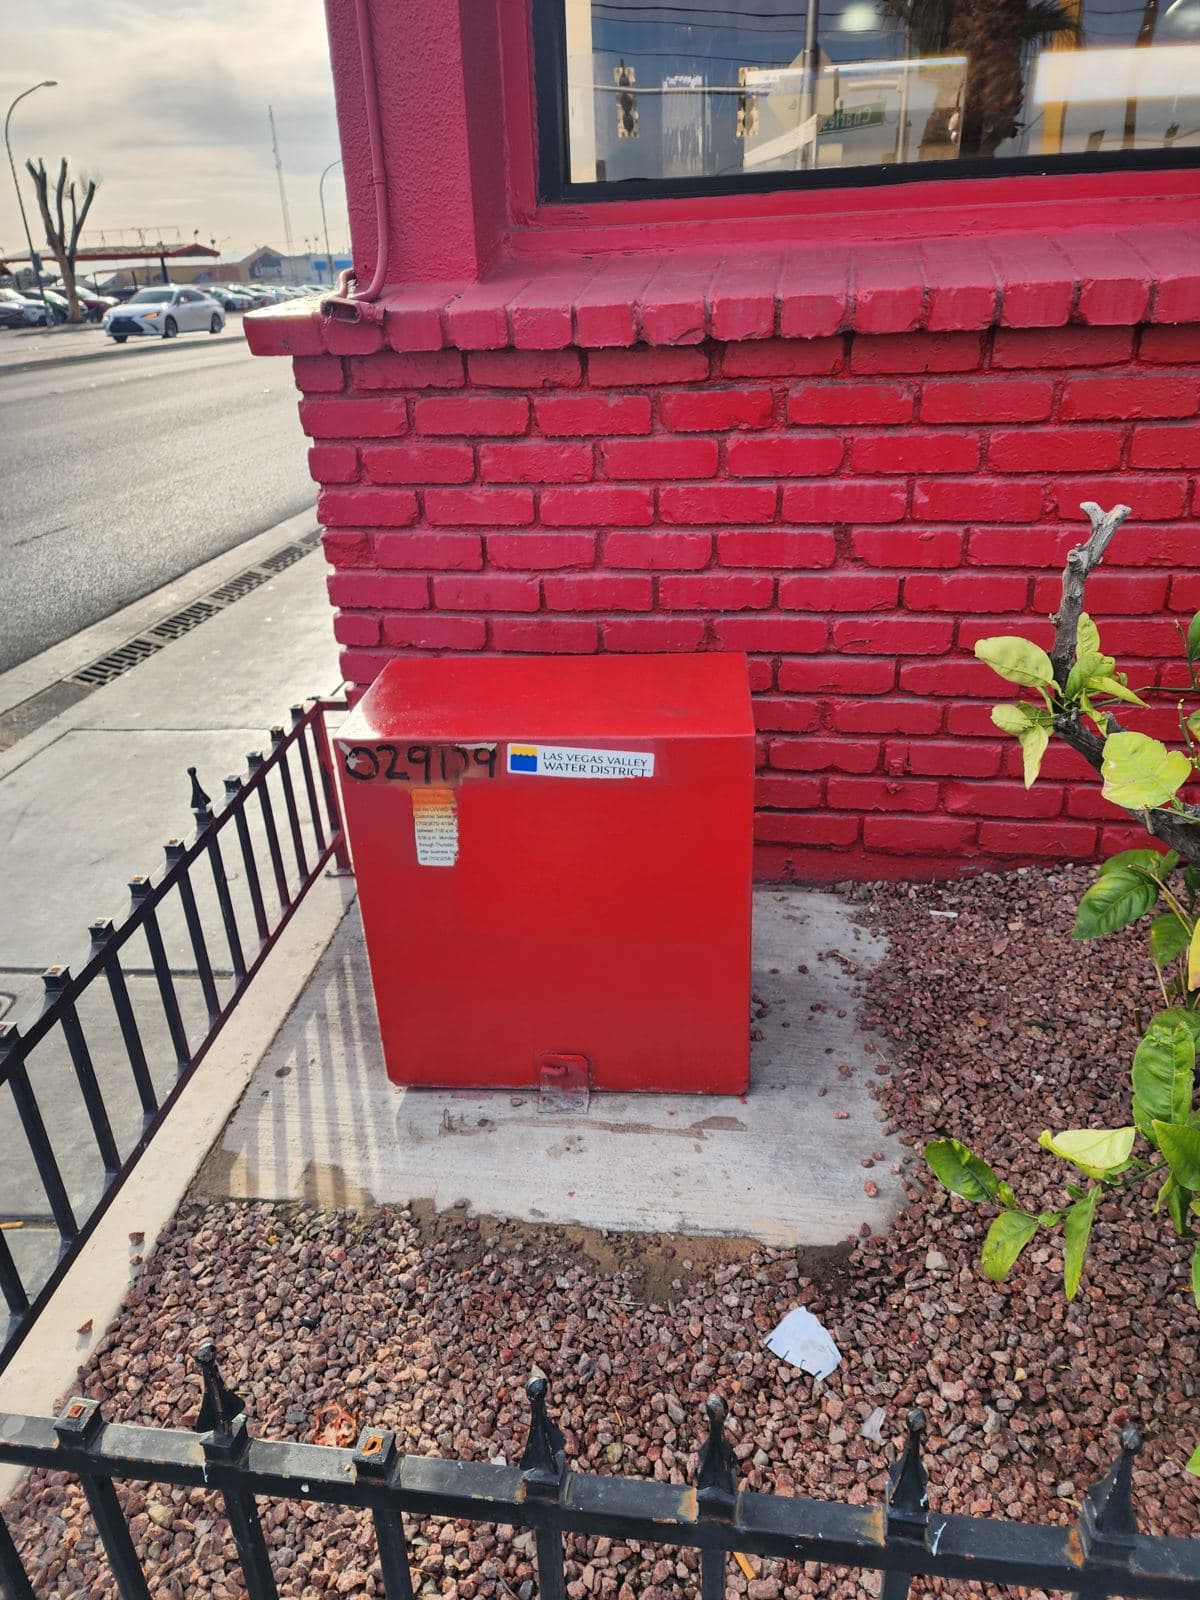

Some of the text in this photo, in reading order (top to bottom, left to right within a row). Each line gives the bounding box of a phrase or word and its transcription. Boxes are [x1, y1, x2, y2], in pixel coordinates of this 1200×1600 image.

[543, 752, 648, 767] LAS VEGAS VALLEY
[543, 762, 648, 777] WATER DISTRICT
